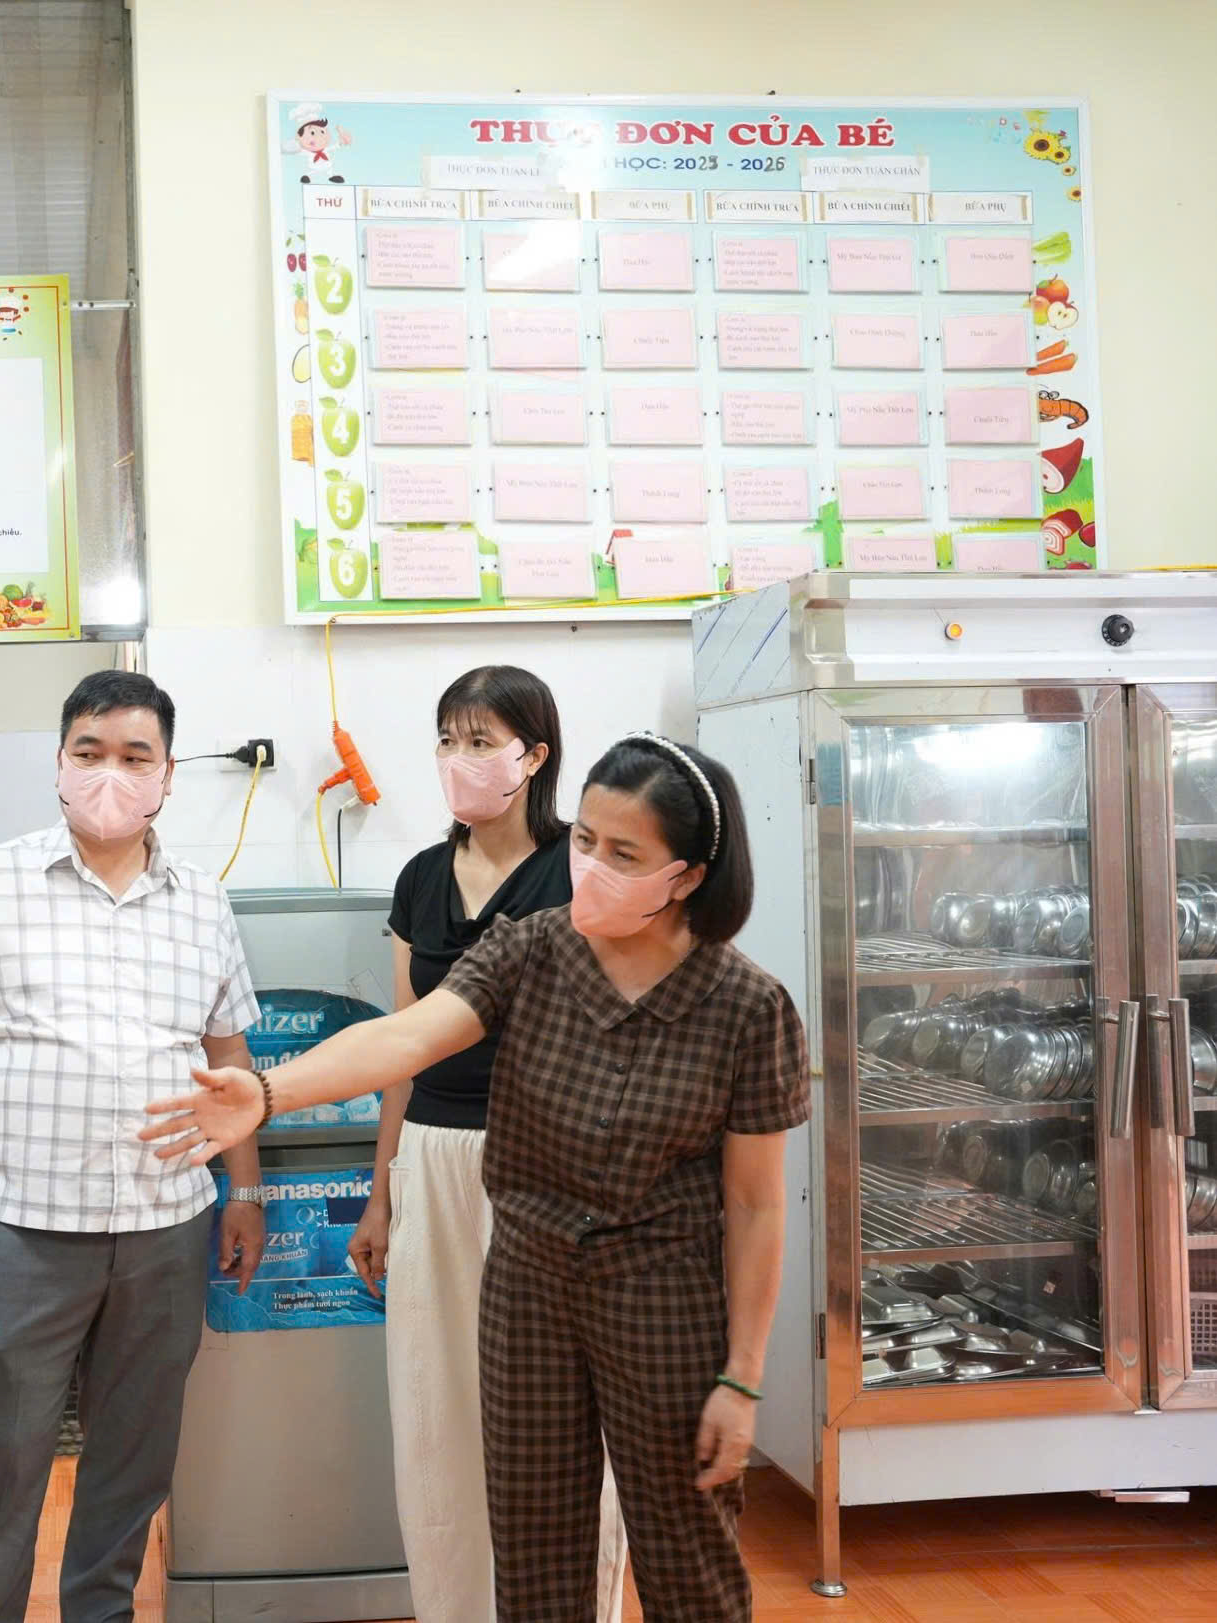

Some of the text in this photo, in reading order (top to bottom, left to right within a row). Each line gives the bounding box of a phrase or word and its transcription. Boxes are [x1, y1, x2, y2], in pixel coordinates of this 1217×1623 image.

[615, 120, 714, 146] ĐƠN
[728, 115, 825, 147] CỦA
[837, 118, 895, 147] BÉ
[326, 274, 343, 305] 2
[328, 347, 346, 377] 3
[331, 414, 349, 445] 4
[336, 487, 354, 520] 5
[338, 556, 356, 584] 6
[267, 1176, 373, 1201] anasonic
[273, 1291, 296, 1300] Trong
